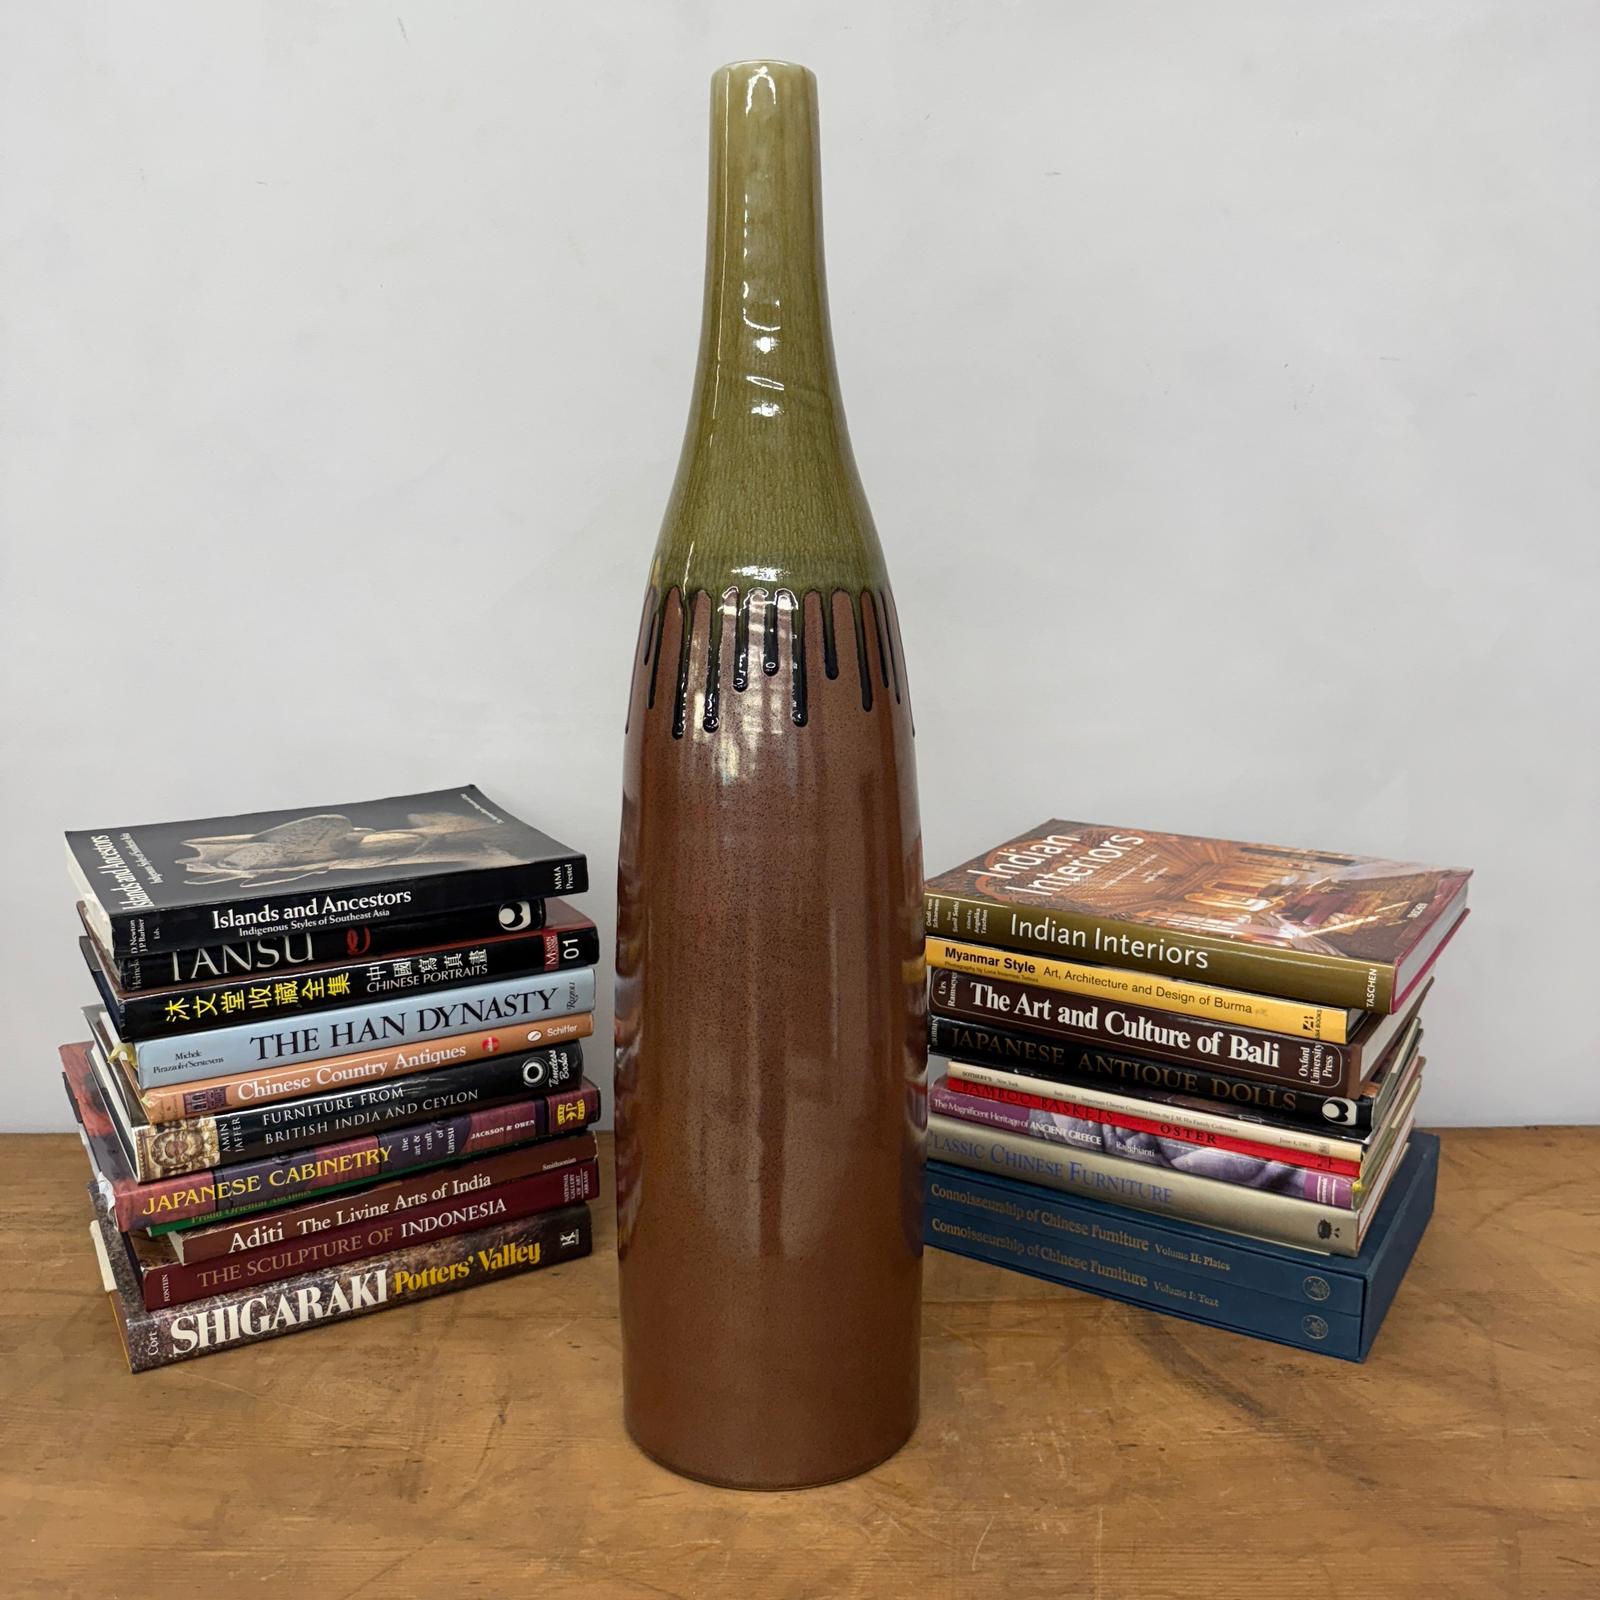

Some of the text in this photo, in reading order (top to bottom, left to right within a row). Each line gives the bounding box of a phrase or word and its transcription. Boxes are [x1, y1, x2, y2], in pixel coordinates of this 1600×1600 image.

[91, 835, 128, 869] Ancestors
[966, 834, 1081, 879] Indian
[1004, 834, 1144, 896] Interiors
[100, 868, 136, 883] and
[554, 866, 562, 890] MMA
[564, 863, 573, 889] Prestel
[110, 882, 155, 909] Islands
[213, 891, 412, 930] Islands and Ancestors
[130, 919, 138, 946] Newton
[239, 908, 390, 937] Indigenous Styles of Southeast Asia
[1011, 913, 1086, 948] Indian
[1095, 927, 1209, 969] Interiors
[563, 938, 579, 959] 01
[367, 964, 488, 993] CHINESE PORTRAITS
[945, 947, 1000, 966] Myanmar
[1003, 957, 1036, 974] Style
[1043, 966, 1061, 980] Art,
[1064, 970, 1129, 991] Architecture
[1131, 983, 1152, 995] and
[1156, 986, 1195, 1004] Design
[1199, 993, 1211, 1006] of
[1214, 996, 1252, 1014] Burma
[1366, 968, 1377, 1008] TASCHEN
[250, 987, 559, 1061] THE HAN DYNASTY
[547, 1024, 577, 1037] Schiffer
[970, 982, 1280, 1068] The Art and Culture of Bali
[238, 1046, 466, 1101] Chinese Country Antiques
[558, 1052, 570, 1080] Books
[952, 1028, 1065, 1066] JAPANESE
[1078, 1053, 1199, 1092] ANTIQUE
[1211, 1078, 1296, 1111] DOLLS
[1299, 1046, 1310, 1077] Oxford
[1310, 1044, 1324, 1085] University
[1322, 1055, 1333, 1078] Press
[263, 1087, 404, 1126] FURNITURE FROM
[265, 1089, 479, 1145] BRITISH INDIA AND CEYLON
[935, 1099, 946, 1110] The
[948, 1102, 990, 1119] Magnificent
[990, 1111, 1019, 1128] Heritage
[1020, 1120, 1029, 1128] of
[1030, 1122, 1067, 1137] ANCIENT
[1069, 1130, 1102, 1145] GREECE
[962, 1080, 1033, 1105] BAMBOO
[1041, 1097, 1113, 1122] BASKETS
[1160, 1124, 1217, 1144] OSTER
[220, 1123, 230, 1152] AMIN
[233, 1117, 242, 1153] JAFFER
[437, 1130, 444, 1138] of
[471, 1127, 504, 1140] JACKSON
[514, 1119, 535, 1130] OWEN
[143, 1145, 392, 1215] JAPANESE CABINETRY
[991, 1143, 1063, 1178] CHINESE
[1070, 1161, 1173, 1204] FURNITURE
[228, 1173, 491, 1254] Aditi The Living Arts of India
[931, 1183, 1024, 1220] Connoisseurship
[1026, 1209, 1039, 1221] of
[1041, 1211, 1088, 1236] Chinese
[1091, 1224, 1149, 1251] Furniture
[1154, 1243, 1188, 1260] Volume
[1203, 1255, 1230, 1271] Plates
[196, 1198, 507, 1288] THE SCULPTURE OF INDONESIA
[931, 1217, 1024, 1255] Connoisseurship
[1027, 1244, 1040, 1256] of
[1040, 1246, 1087, 1271] Chinese
[1090, 1259, 1148, 1287] Furniture
[1153, 1281, 1187, 1298] Volume
[1198, 1292, 1219, 1308] Text
[170, 1240, 541, 1354] SHIGARAKI Potters' Valley
[148, 1331, 158, 1356] Cort
